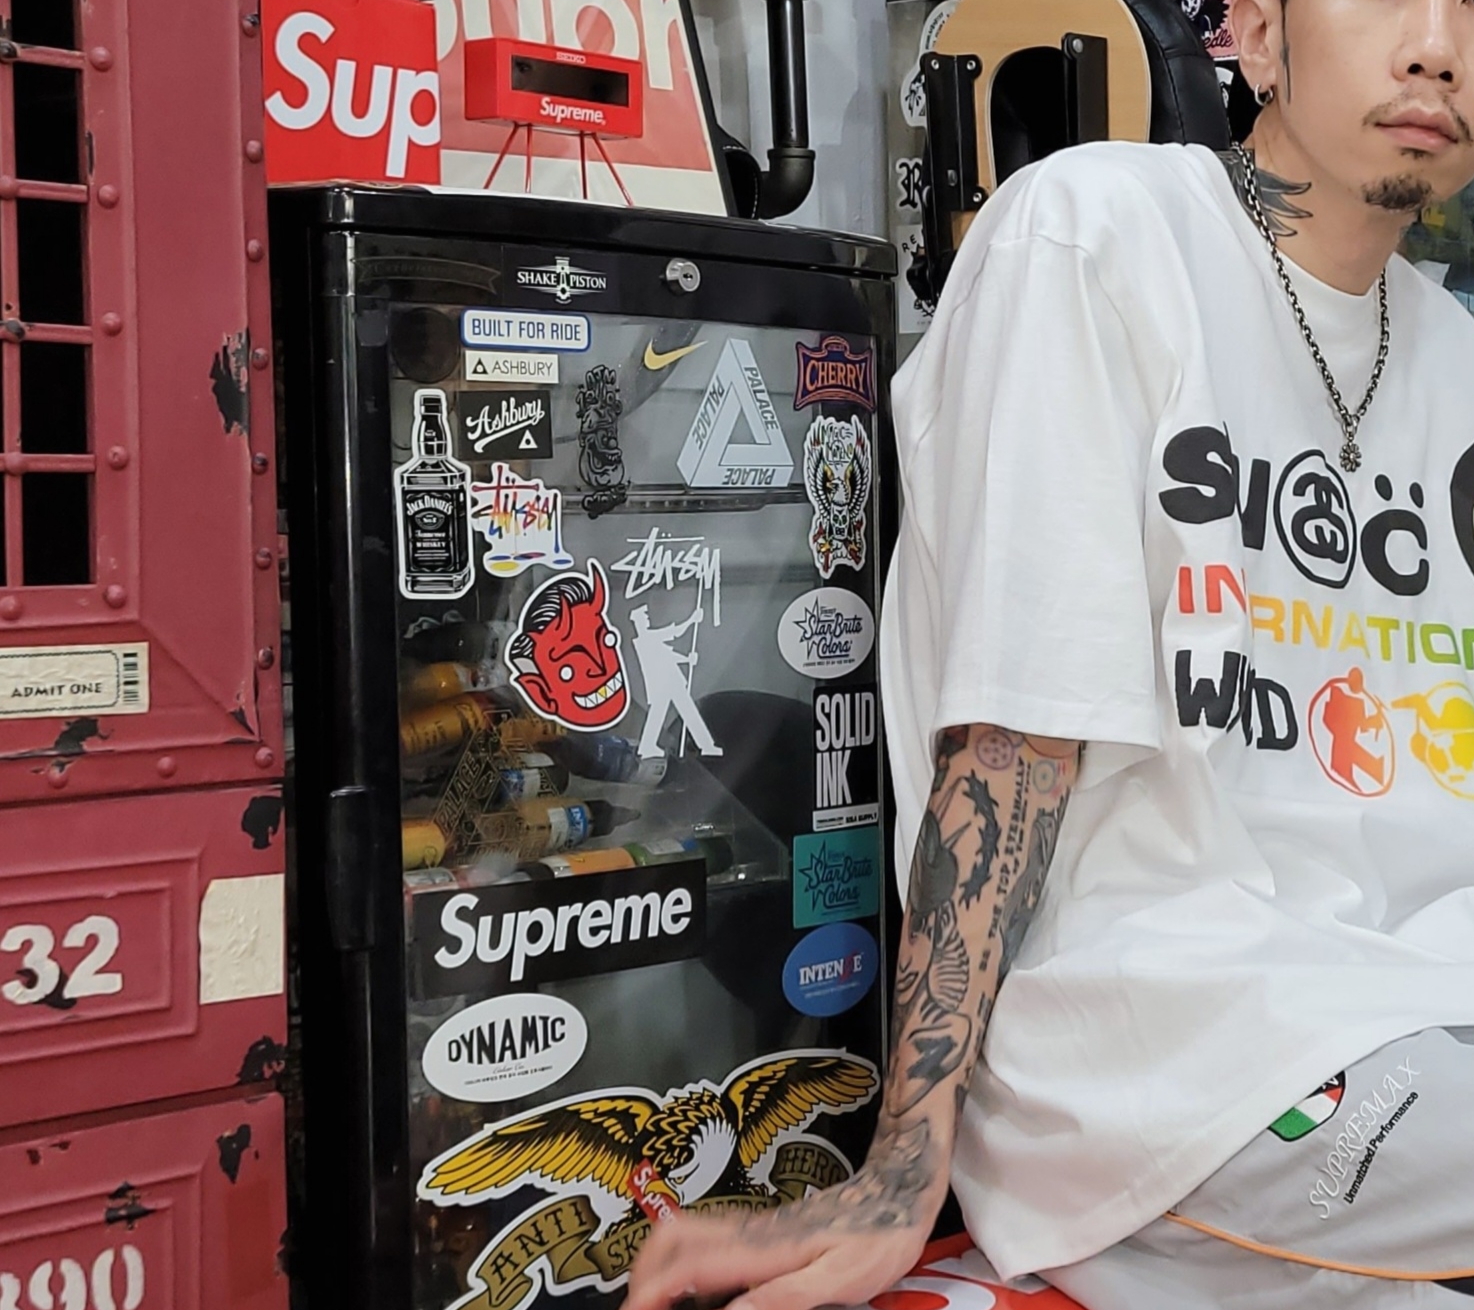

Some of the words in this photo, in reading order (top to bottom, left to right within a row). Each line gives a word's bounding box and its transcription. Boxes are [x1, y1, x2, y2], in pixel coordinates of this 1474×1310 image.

[517, 270, 556, 288] SHAKE
[569, 274, 606, 290] PISTON
[472, 318, 513, 339] BUILT
[518, 321, 546, 339] FOR
[550, 322, 581, 341] RIDE
[491, 359, 553, 377] ASHBURY
[805, 360, 866, 393] CHERRY
[466, 397, 545, 440] Ashbury
[692, 375, 724, 450] PALACE
[744, 366, 779, 431] PALACE
[722, 467, 776, 486] PALACE
[11, 683, 66, 698] ADMIT
[70, 681, 104, 695] ONE
[816, 692, 875, 751] SOLID
[817, 750, 852, 808] INK
[434, 887, 692, 982] Supreme
[988, 903, 1003, 939] THE
[448, 1015, 565, 1065] DYNAMIC
[1309, 1056, 1421, 1220] SUPREMAX
[1343, 1144, 1375, 1204] Unmatched
[1369, 1091, 1418, 1149] Performance
[490, 1201, 589, 1286] ANTI
